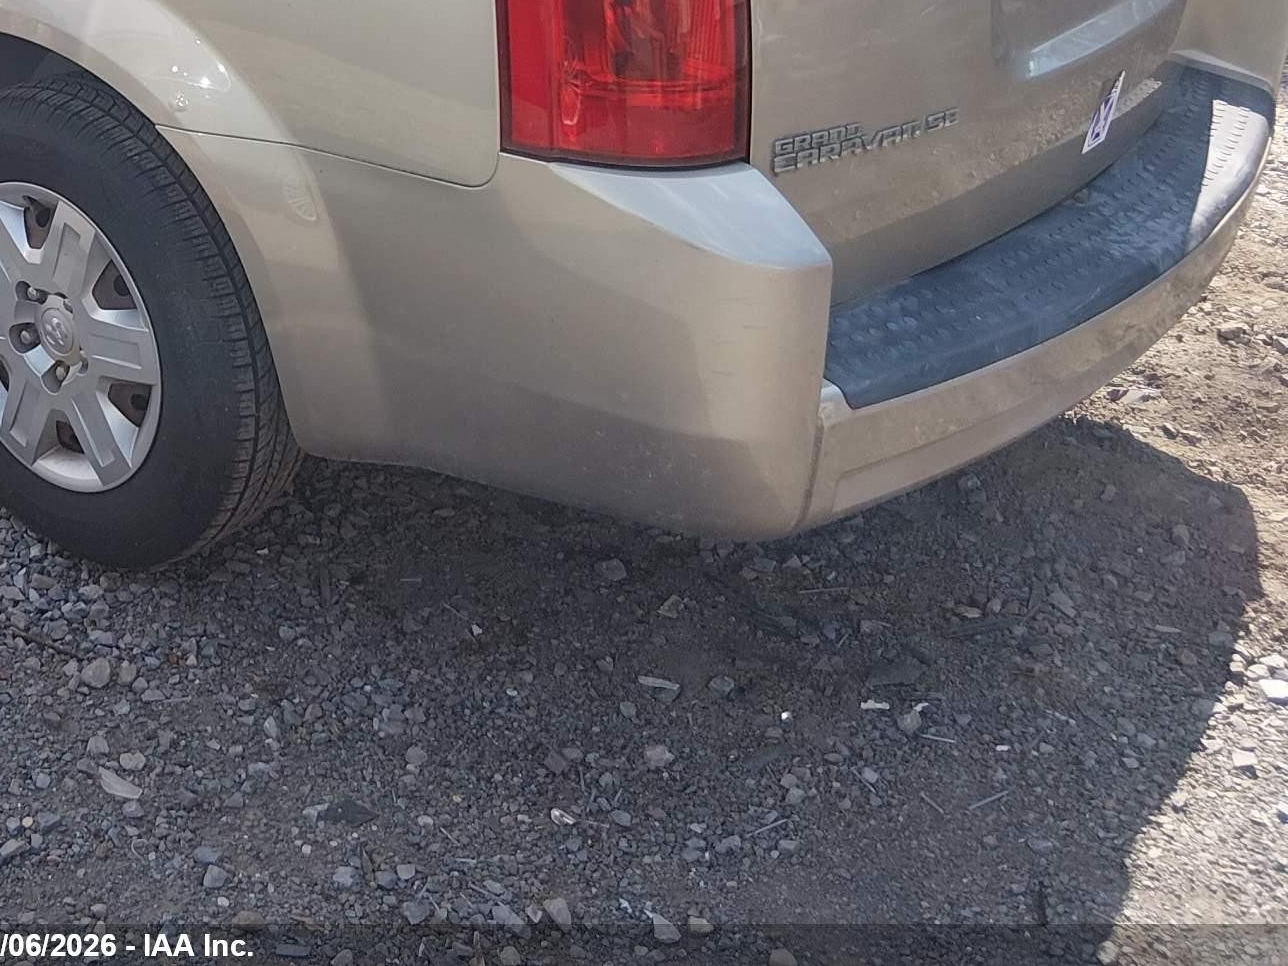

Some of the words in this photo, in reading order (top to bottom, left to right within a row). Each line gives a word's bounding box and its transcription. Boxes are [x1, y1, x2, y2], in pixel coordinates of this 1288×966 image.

[773, 121, 921, 174] CARAVAN
[925, 107, 960, 132] SE
[774, 122, 862, 156] GRAND
